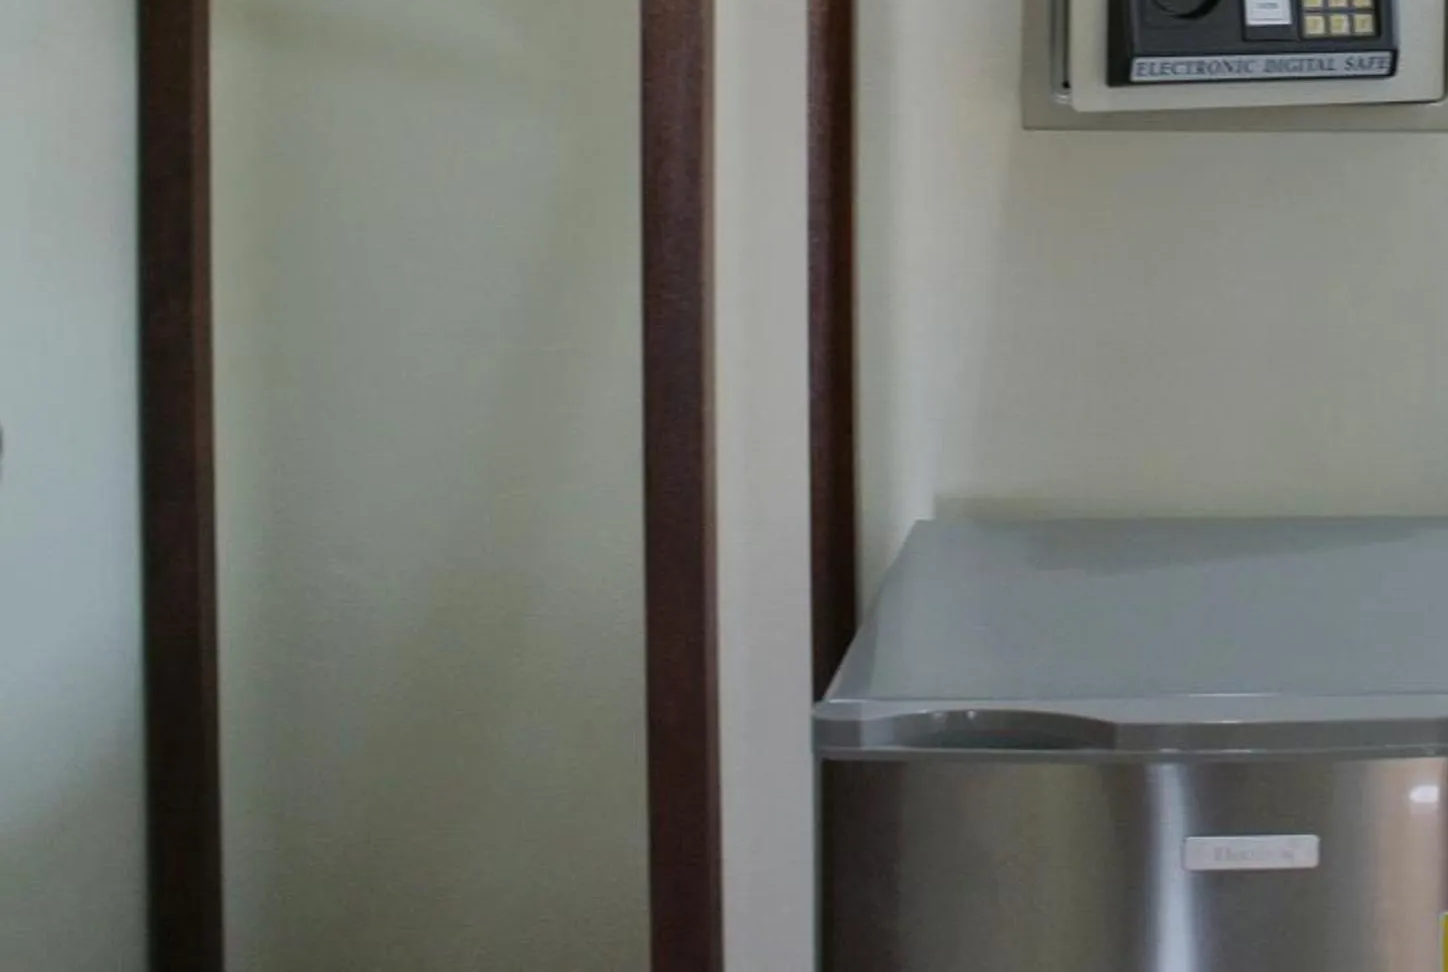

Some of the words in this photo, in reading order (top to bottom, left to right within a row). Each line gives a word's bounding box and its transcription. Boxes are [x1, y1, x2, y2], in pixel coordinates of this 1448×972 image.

[1136, 58, 1253, 77] ELECTRONIC
[1264, 56, 1335, 74] DIGITAL
[1344, 54, 1392, 72] SAFE
